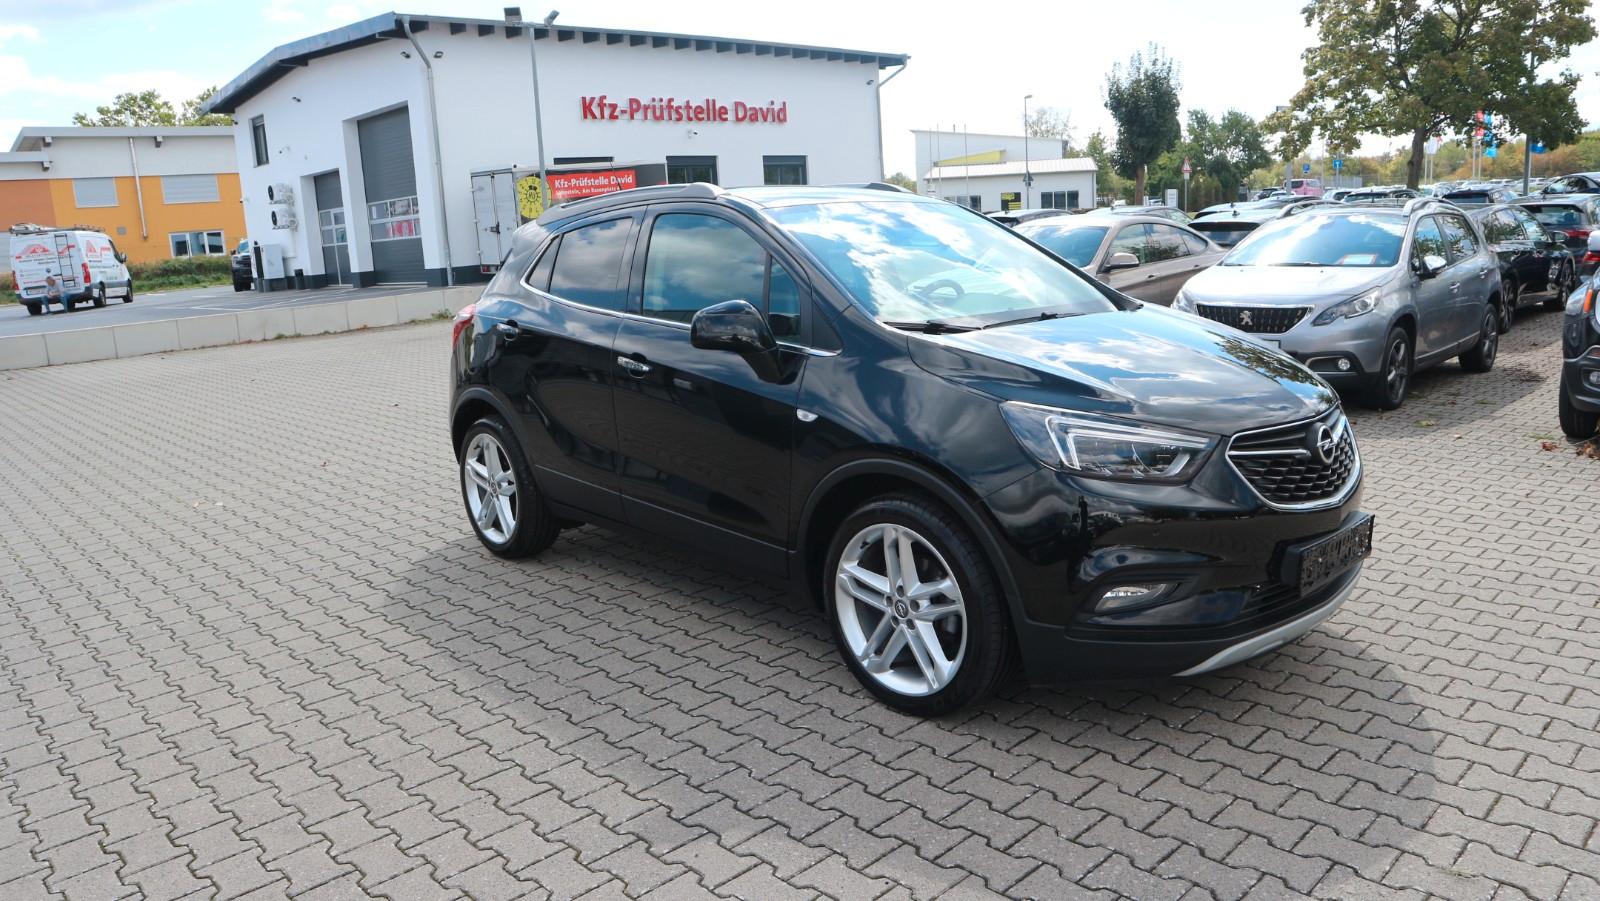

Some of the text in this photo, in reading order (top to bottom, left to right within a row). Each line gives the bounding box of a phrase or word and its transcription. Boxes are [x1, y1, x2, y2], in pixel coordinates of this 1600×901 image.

[581, 95, 787, 122] Kfz-Prüfstelle David
[555, 175, 633, 188] Kfz-Prüfstelle David
